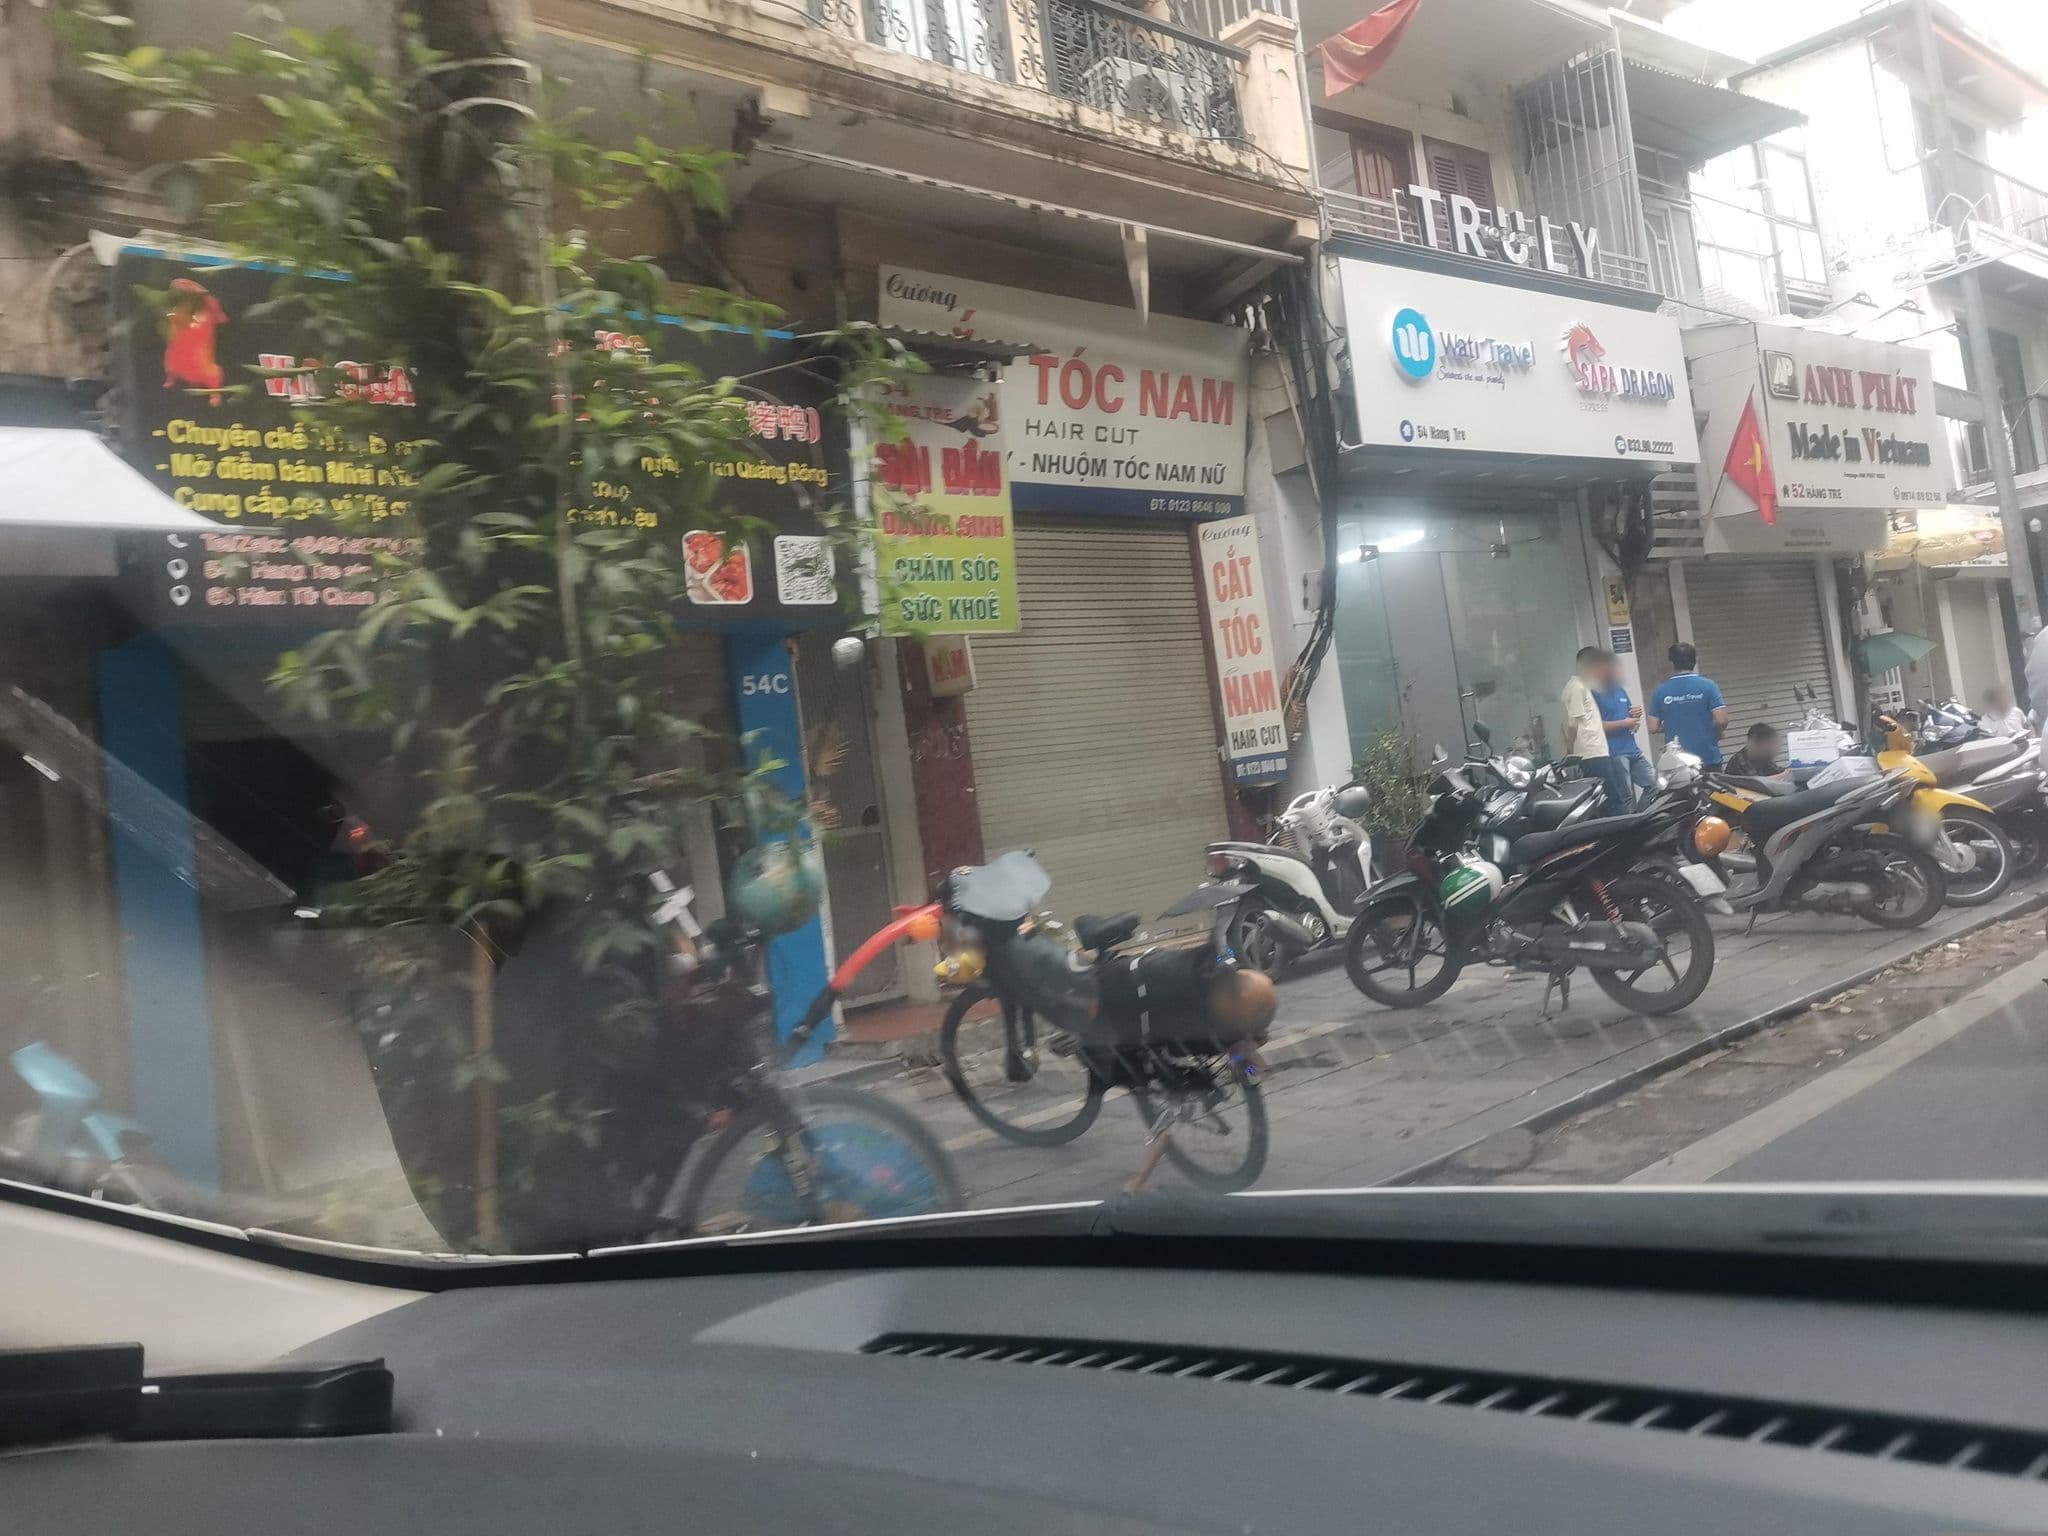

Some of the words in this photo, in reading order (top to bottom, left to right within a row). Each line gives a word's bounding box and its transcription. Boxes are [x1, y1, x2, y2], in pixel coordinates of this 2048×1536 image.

[1408, 184, 1597, 279] TRULY
[1485, 338, 1536, 367] Travel
[1029, 346, 1125, 413] TÓC
[1140, 369, 1235, 426] NAM
[1580, 362, 1618, 393] SAPA
[1620, 367, 1675, 400] DRAGON
[1803, 364, 1857, 408] ANH
[1859, 369, 1918, 415] PHÁT
[1025, 418, 1085, 440] HAIR
[1095, 425, 1139, 445] CUT
[1787, 421, 1841, 461] Made
[1843, 428, 1862, 462] in
[1861, 427, 1931, 467] Vietnam
[1032, 451, 1107, 482] NHUỘM
[1114, 455, 1150, 480] TÓC
[1155, 463, 1196, 484] NAM
[1201, 463, 1226, 485] NỮ
[1791, 483, 1805, 499] 52
[1828, 488, 1842, 499] TRE
[895, 553, 955, 583] CHĂM
[960, 553, 1000, 583] SÓC
[1212, 544, 1254, 603] CẮT
[902, 592, 942, 622] SỨC
[1219, 608, 1263, 659] TÓC
[742, 673, 789, 696] 54C
[1223, 670, 1277, 718] NAM
[1232, 728, 1258, 751] HAIR
[1260, 724, 1282, 746] CUT
